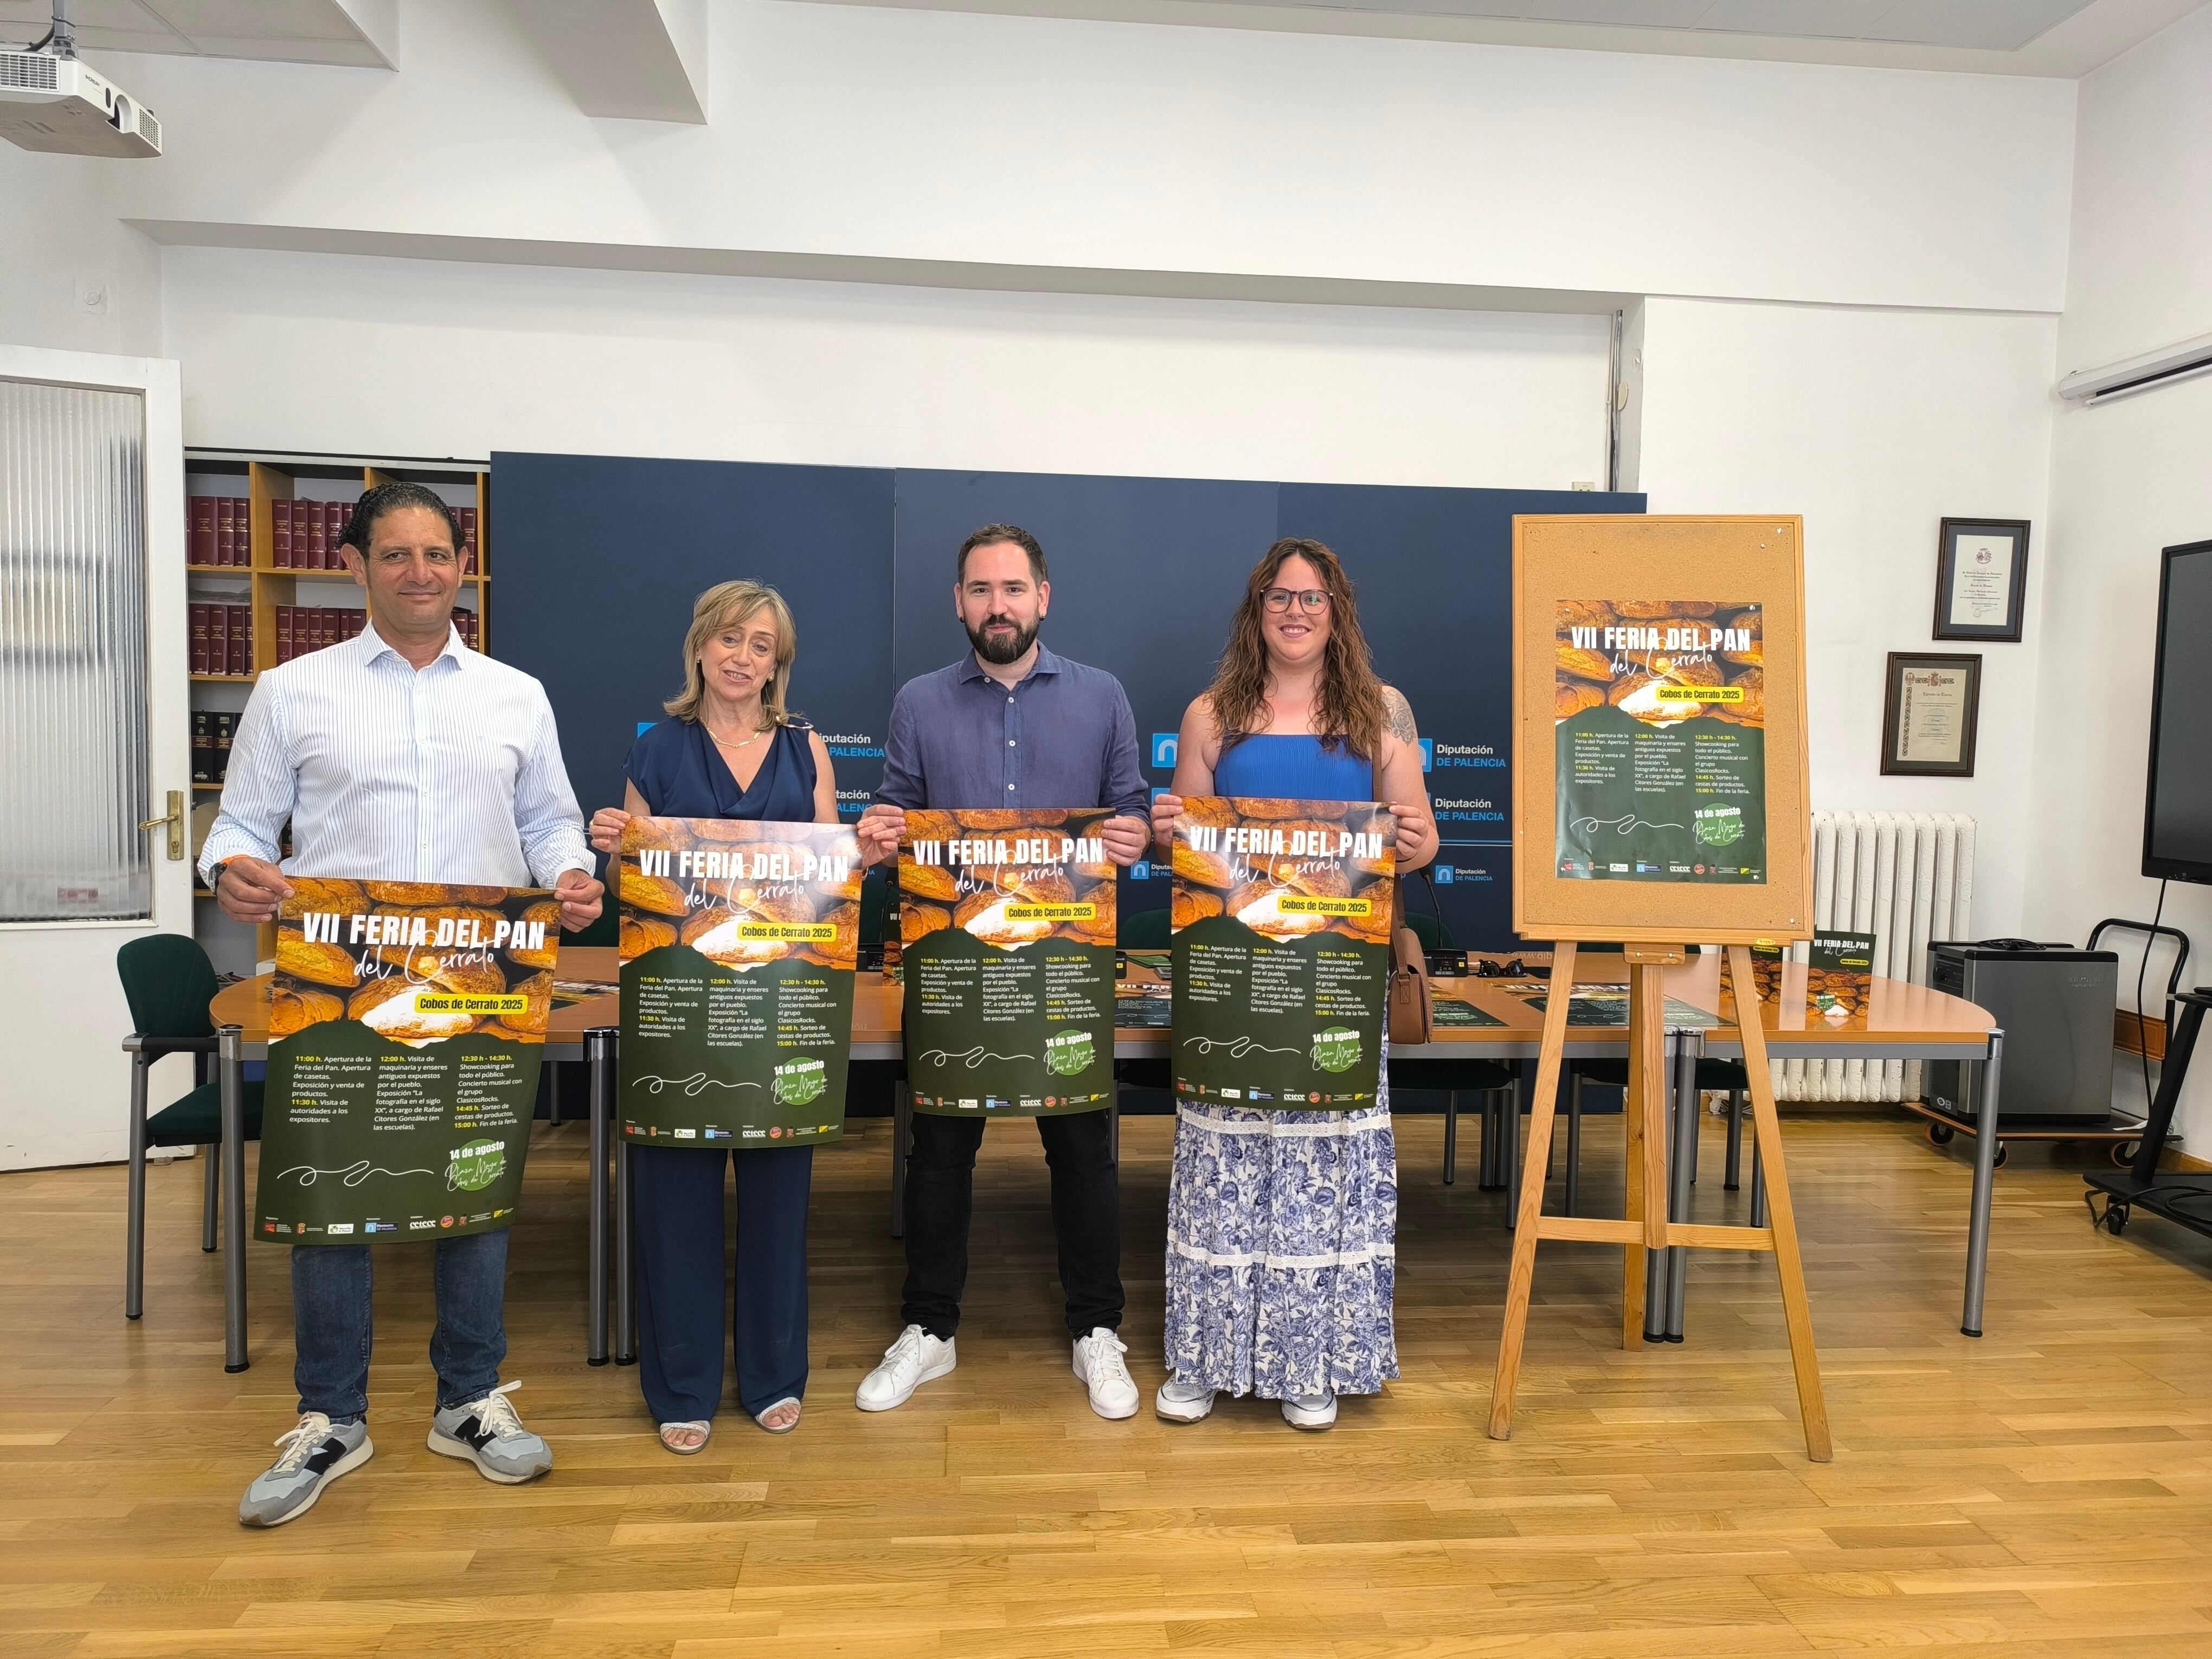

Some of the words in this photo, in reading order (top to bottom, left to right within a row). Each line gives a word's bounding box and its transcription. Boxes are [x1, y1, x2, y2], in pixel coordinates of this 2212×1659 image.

[1571, 626, 1597, 649] VII
[1604, 627, 1659, 650] FERIA
[1667, 628, 1703, 651] DEL
[1711, 628, 1751, 651] PAN
[1610, 650, 1637, 676] del
[1646, 637, 1713, 679] Cerrato
[1660, 690, 1681, 698] Cobos
[1683, 690, 1693, 698] de
[1694, 690, 1720, 698] Cerrato
[1721, 691, 1740, 699] 2025
[819, 733, 871, 744] iputación
[829, 747, 885, 757] PALENCIA
[1437, 744, 1493, 755] Diputación
[1437, 758, 1451, 766] DE
[1454, 758, 1506, 767] PALENCIA
[835, 790, 870, 799] tación
[1435, 799, 1491, 809] Diputación
[1435, 812, 1449, 820] DE
[1452, 812, 1504, 821] PALENCIA
[1190, 826, 1217, 852] VII
[1225, 827, 1284, 854] FERIA
[1293, 829, 1330, 857] DEL
[1339, 832, 1382, 859] PAN
[913, 840, 940, 865] VII
[949, 839, 1008, 865] FERIA
[1017, 839, 1054, 864] DEL
[1062, 838, 1103, 863] PAN
[640, 850, 670, 877] VII
[679, 851, 744, 878] FERIA
[754, 853, 795, 881] DEL
[803, 854, 848, 882] PAN
[1229, 853, 1259, 883] del
[1268, 840, 1340, 888] Cerrato
[955, 865, 984, 893] del
[993, 850, 1065, 897] Cerrato
[684, 878, 716, 910] del
[726, 864, 805, 914] Cerrato
[1008, 908, 1031, 917] Cobos
[1033, 908, 1043, 917] de
[1044, 907, 1071, 916] Cerrato
[1073, 906, 1092, 916] 2025
[1282, 900, 1305, 910] Cobos
[1307, 901, 1316, 910] de
[1318, 901, 1346, 911] Cerrato
[1348, 903, 1367, 912] 2025
[304, 912, 340, 943] VII
[349, 915, 426, 946] FERIA
[436, 918, 484, 948] DEL
[493, 921, 545, 950] PAN
[742, 927, 767, 936] Cobos
[769, 927, 779, 937] de
[781, 928, 811, 937] Cerrato
[812, 928, 832, 937] 2025
[353, 944, 393, 980] del
[404, 929, 496, 985] Cerrato
[420, 999, 449, 1009] Cobos
[451, 999, 463, 1009] de
[465, 999, 499, 1009] Cerrato
[500, 1000, 523, 1009] 2025
[484, 1111, 514, 1120] productos.
[449, 1149, 459, 1160] 14
[462, 1148, 473, 1158] de
[475, 1141, 504, 1155] agosto
